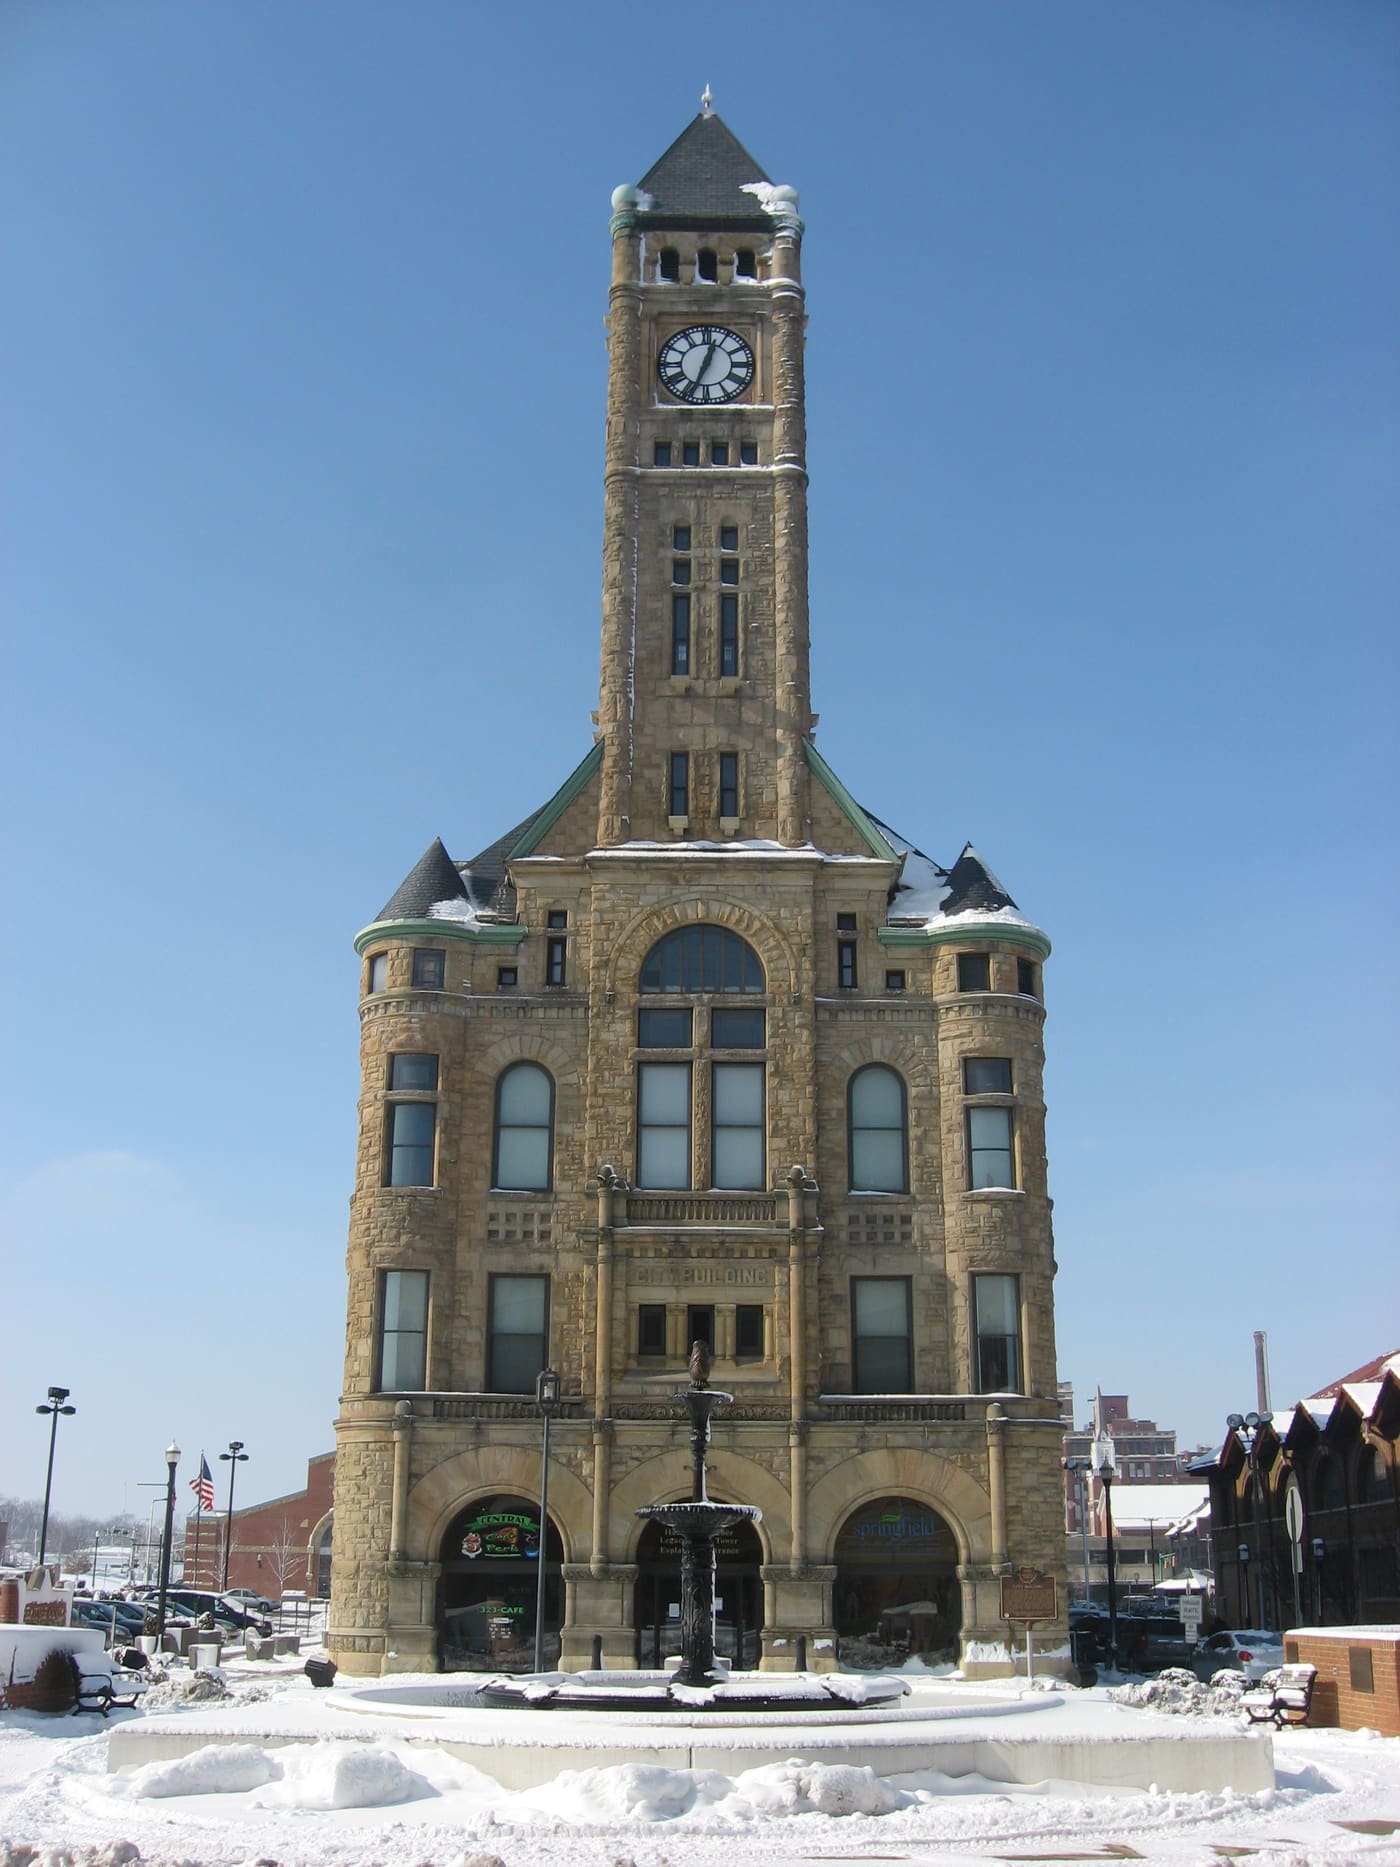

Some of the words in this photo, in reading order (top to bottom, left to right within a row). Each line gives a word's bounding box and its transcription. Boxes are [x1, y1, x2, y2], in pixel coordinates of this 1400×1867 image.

[683, 1267, 768, 1284] BUILDING
[481, 1515, 526, 1524] CENTRAL
[855, 1514, 936, 1542] springfield
